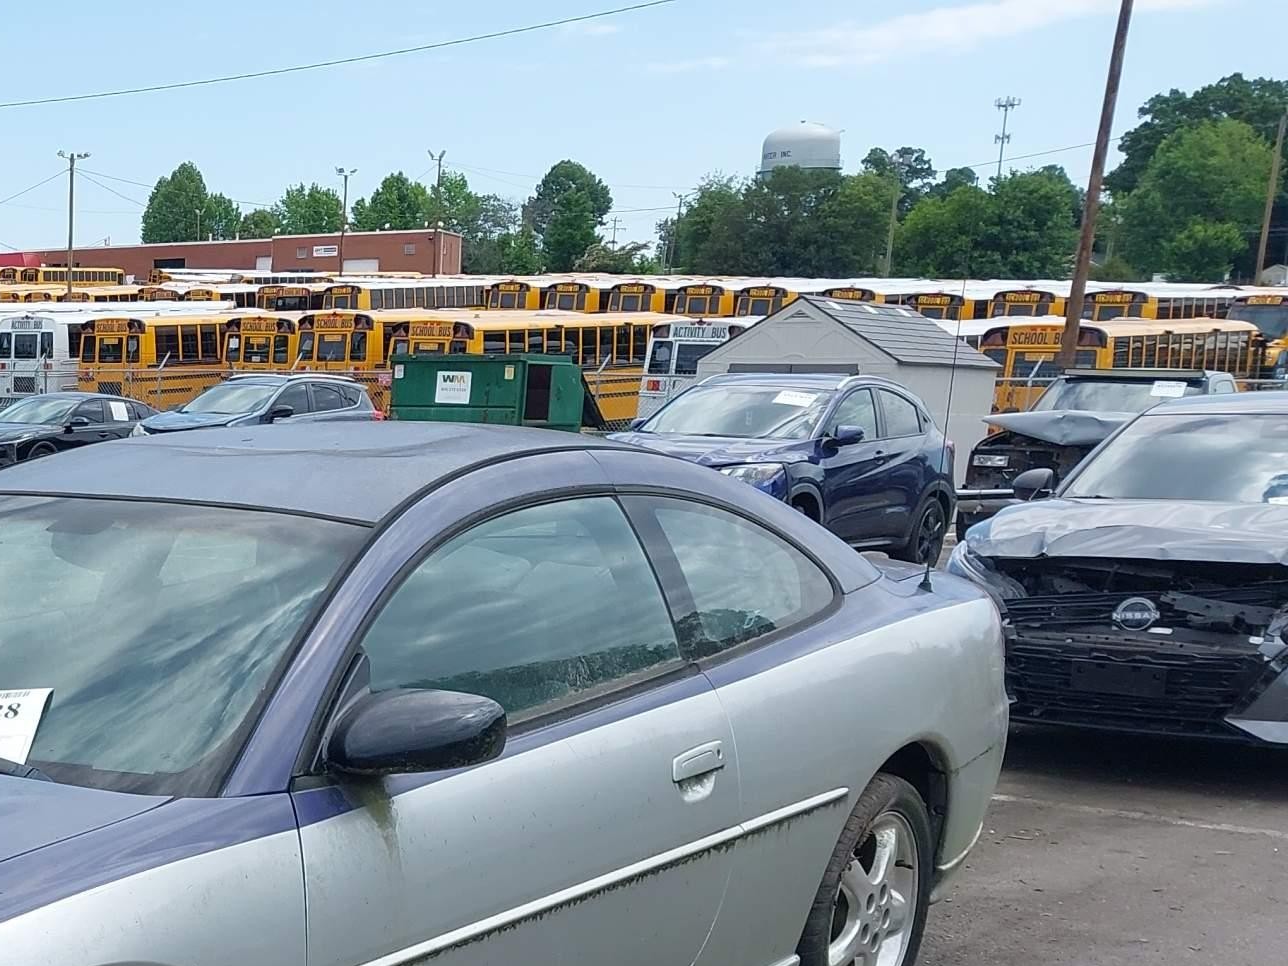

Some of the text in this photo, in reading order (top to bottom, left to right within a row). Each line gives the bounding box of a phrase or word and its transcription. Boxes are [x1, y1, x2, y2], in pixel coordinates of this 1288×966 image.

[12, 321, 43, 329] ACTIVITY BUS
[242, 322, 276, 331] SCHOOL BUS
[316, 319, 353, 329] SCHOOL BUS
[412, 326, 451, 337] SCHOOL BUS
[674, 327, 727, 338] ACTIVITY BUS
[1012, 332, 1048, 345] SCHOOL
[442, 374, 465, 383] WM
[1112, 610, 1160, 621] NISSAN
